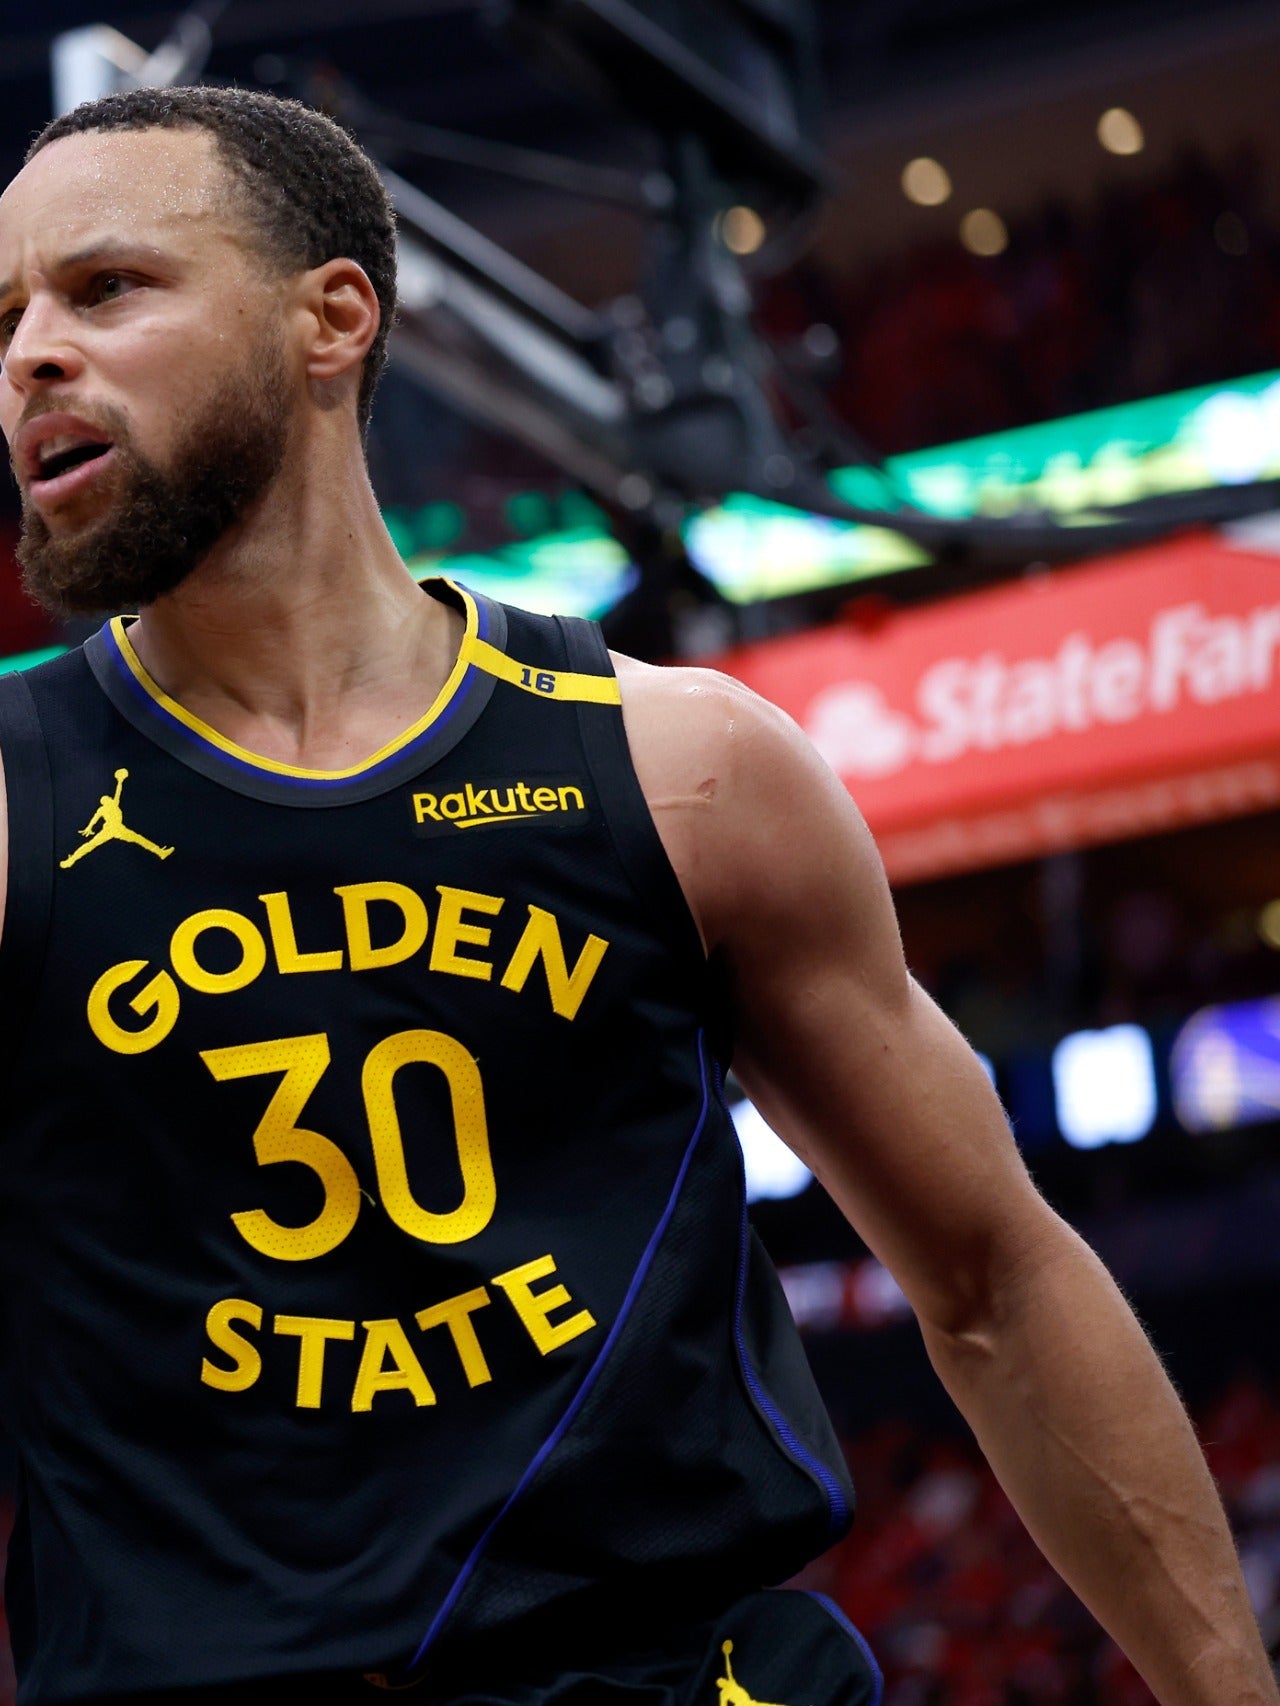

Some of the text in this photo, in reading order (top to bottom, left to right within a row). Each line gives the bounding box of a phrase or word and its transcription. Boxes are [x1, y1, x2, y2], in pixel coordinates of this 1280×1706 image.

[520, 668, 556, 694] 16
[412, 782, 585, 824] Rakuten
[86, 881, 609, 1055] GOLDEN
[199, 1029, 497, 1262] 30
[200, 1254, 597, 1413] STATE
